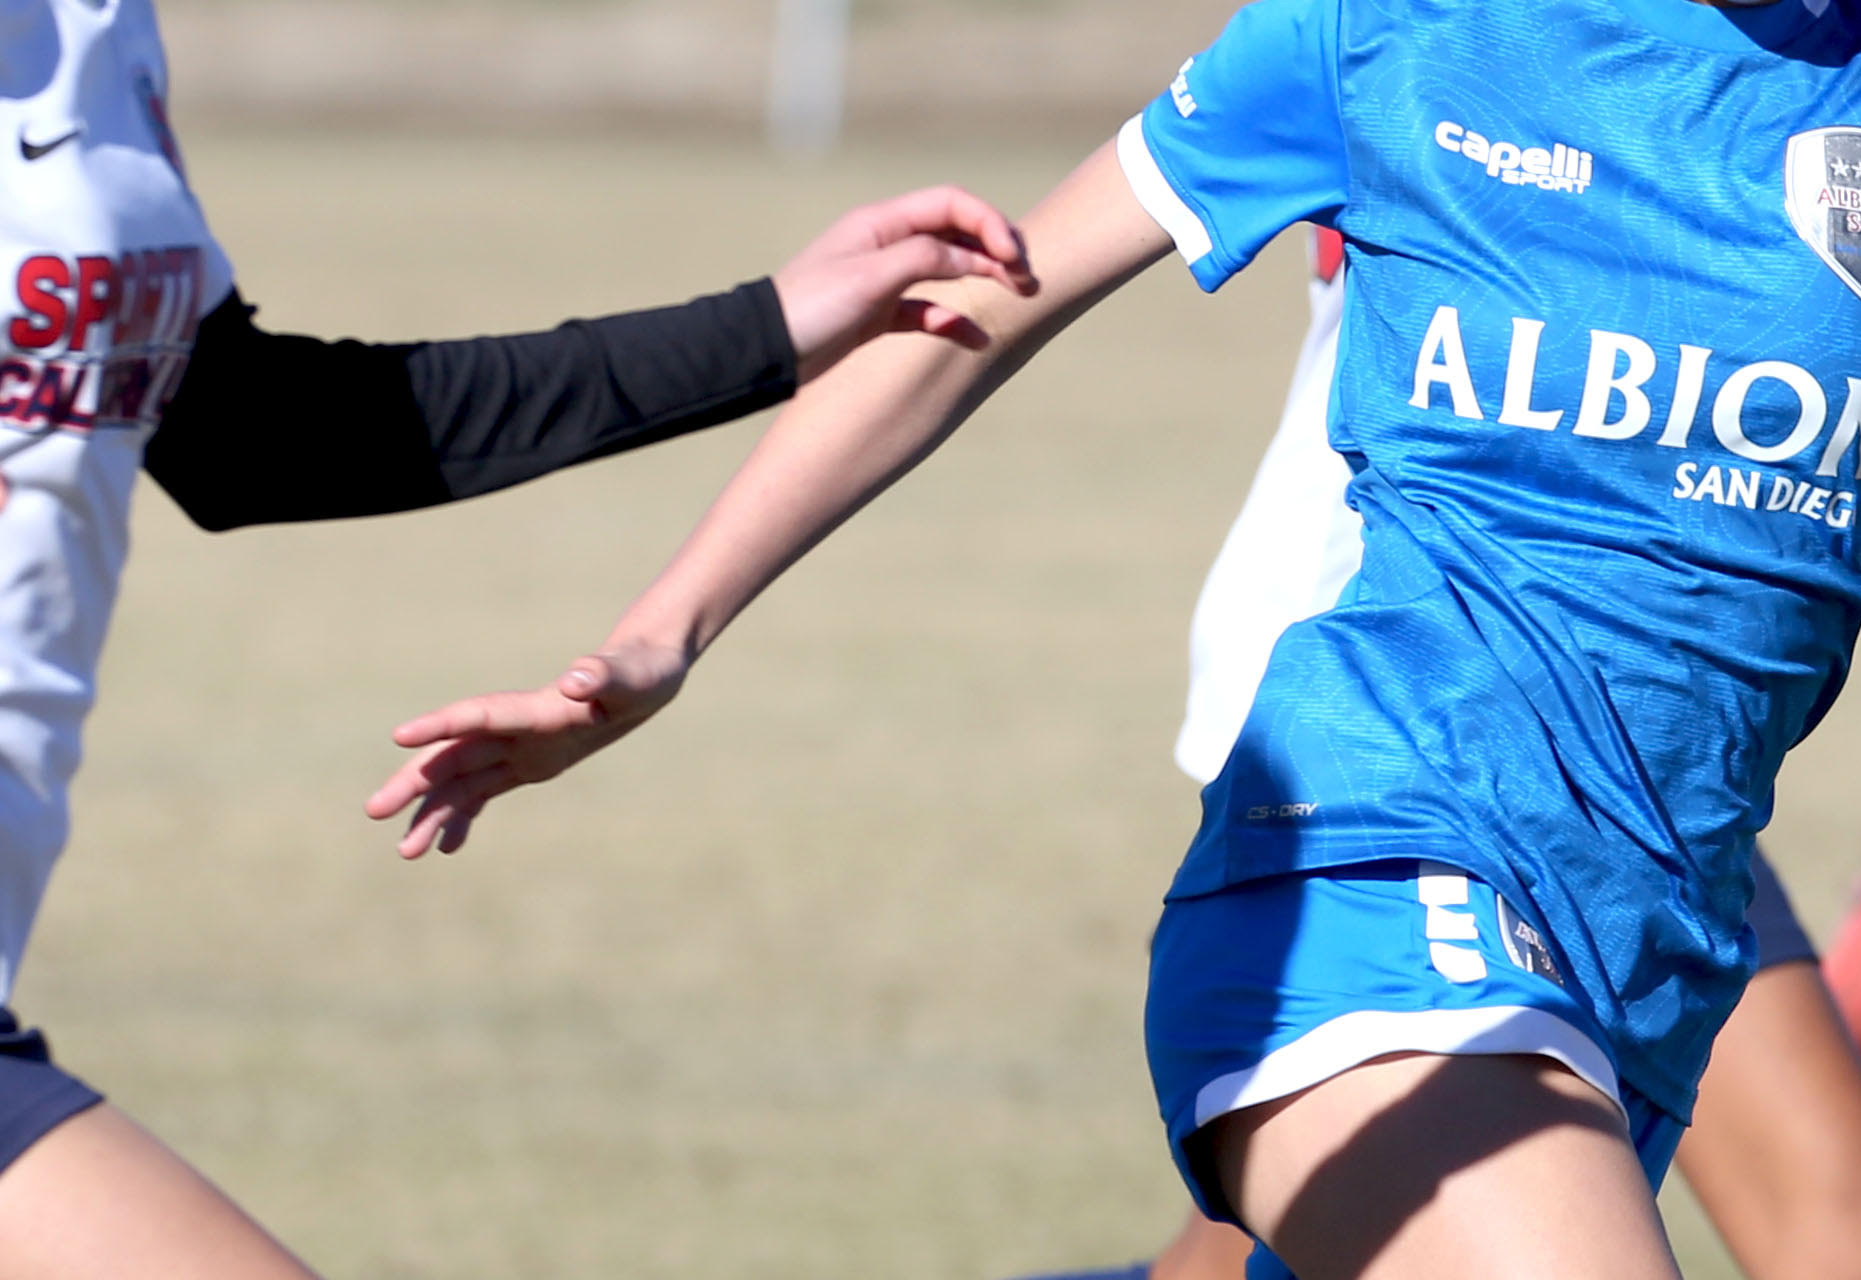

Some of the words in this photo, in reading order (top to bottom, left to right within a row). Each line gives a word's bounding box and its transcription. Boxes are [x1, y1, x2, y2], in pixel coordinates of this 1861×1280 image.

[1434, 120, 1594, 178] capelli
[1501, 169, 1591, 195] SPORT
[1672, 460, 1762, 511] SAN
[1766, 474, 1857, 529] DIEG
